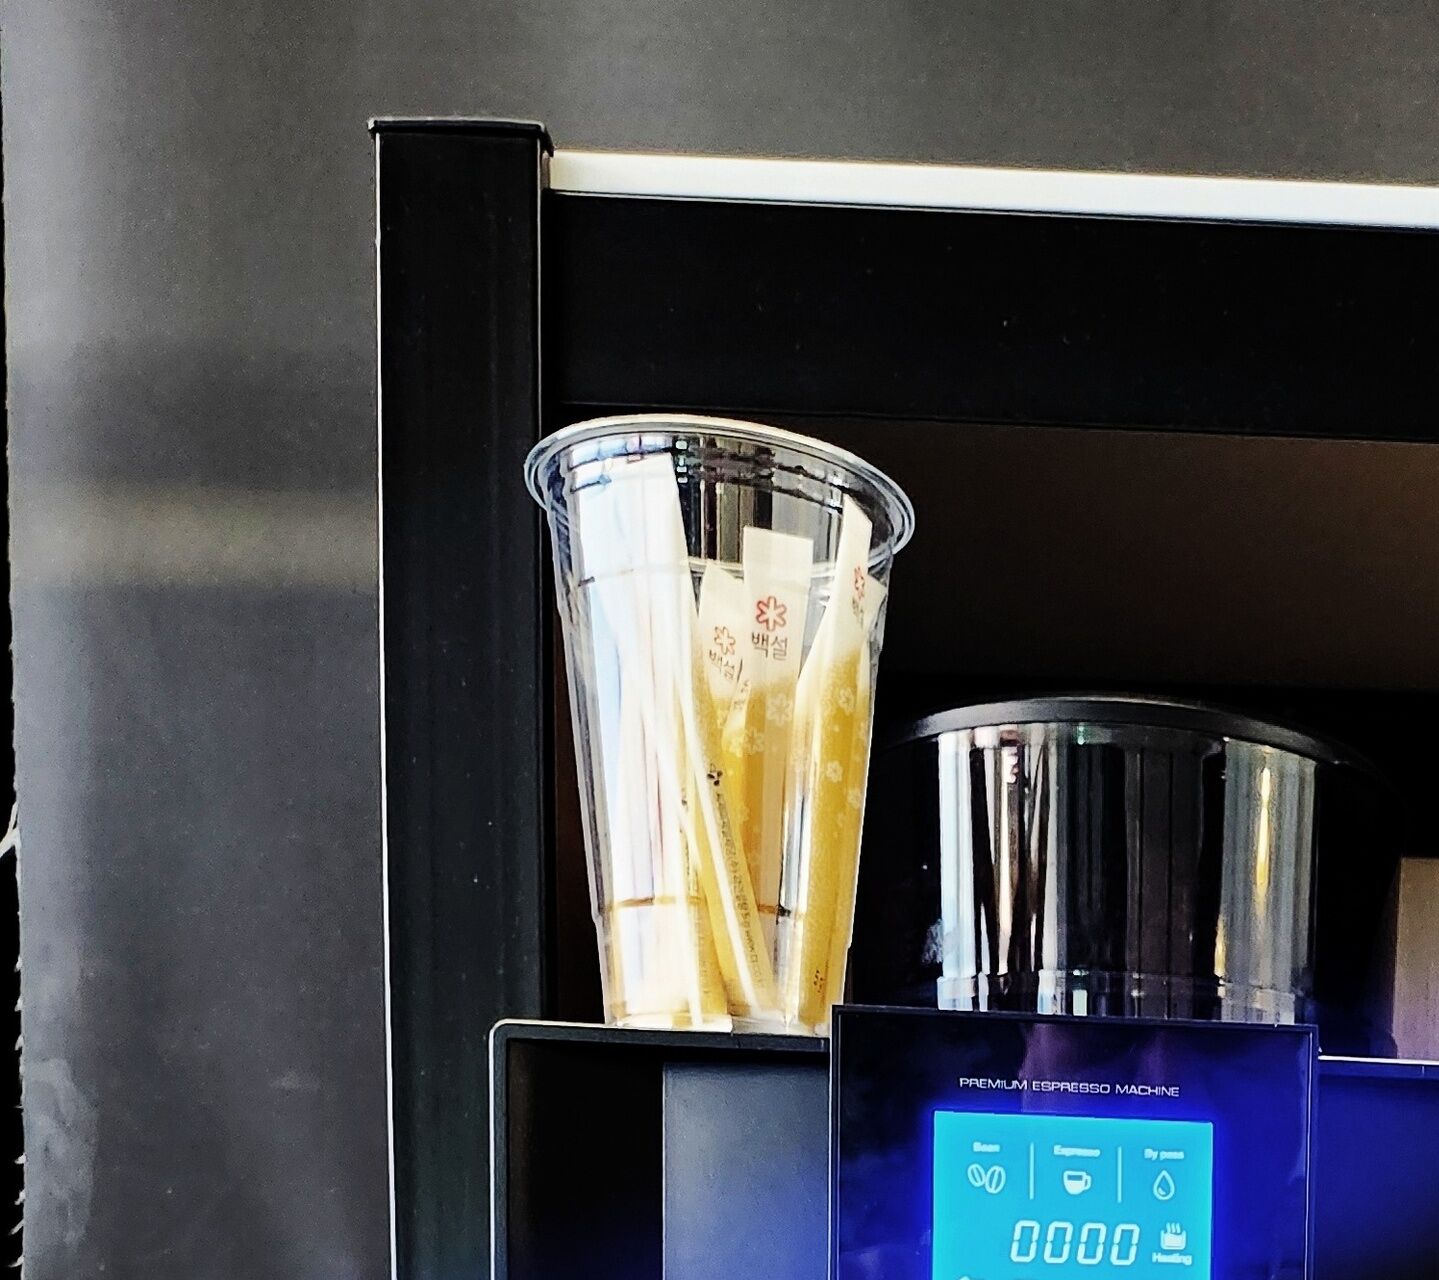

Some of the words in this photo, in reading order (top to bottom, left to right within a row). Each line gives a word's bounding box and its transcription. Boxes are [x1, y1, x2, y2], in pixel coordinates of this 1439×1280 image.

[751, 632, 788, 661] 백설
[959, 1077, 1027, 1090] PREMIUM
[1032, 1080, 1110, 1094] ESPRESSO
[1115, 1083, 1180, 1097] MACHINE
[1010, 1219, 1140, 1266] 0000
[1152, 1252, 1193, 1266] Heating
